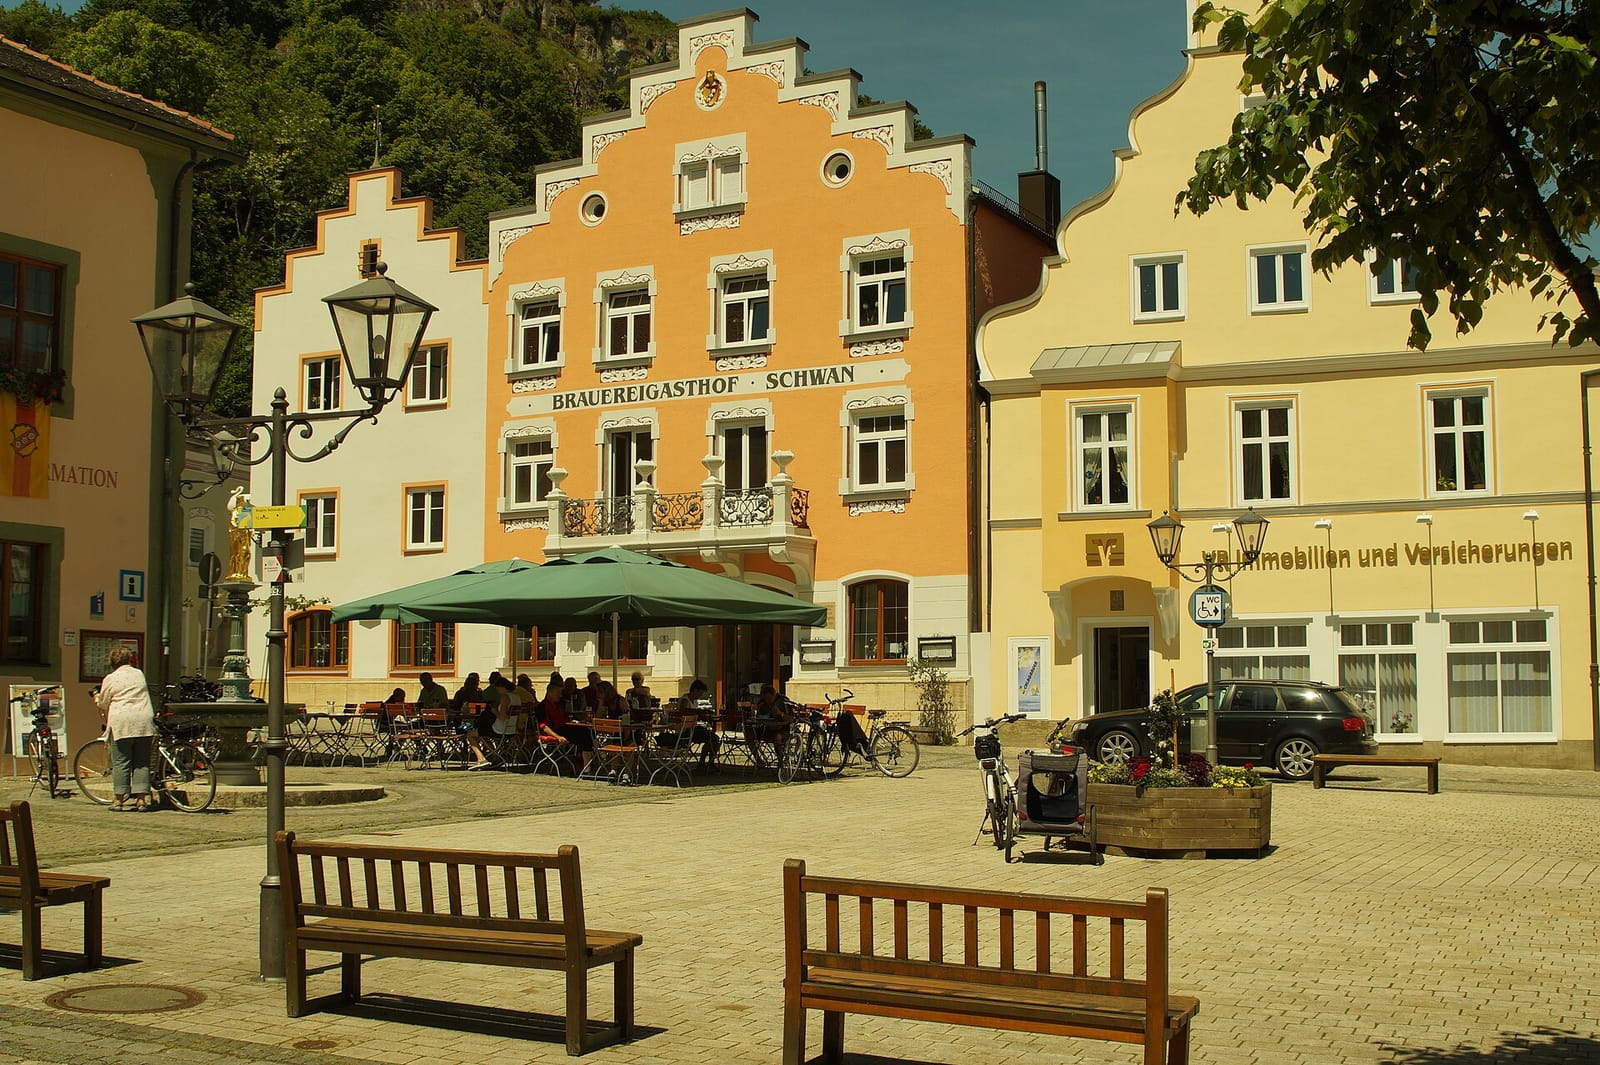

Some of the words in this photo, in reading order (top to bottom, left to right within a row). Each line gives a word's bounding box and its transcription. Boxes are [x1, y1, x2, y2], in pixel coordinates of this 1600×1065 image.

[552, 376, 739, 410] BRAUEREIGASTHOF
[766, 366, 855, 390] SCHWAN
[48, 463, 118, 489] MATION
[1358, 543, 1398, 568] und
[1404, 540, 1573, 567] Versicherungen
